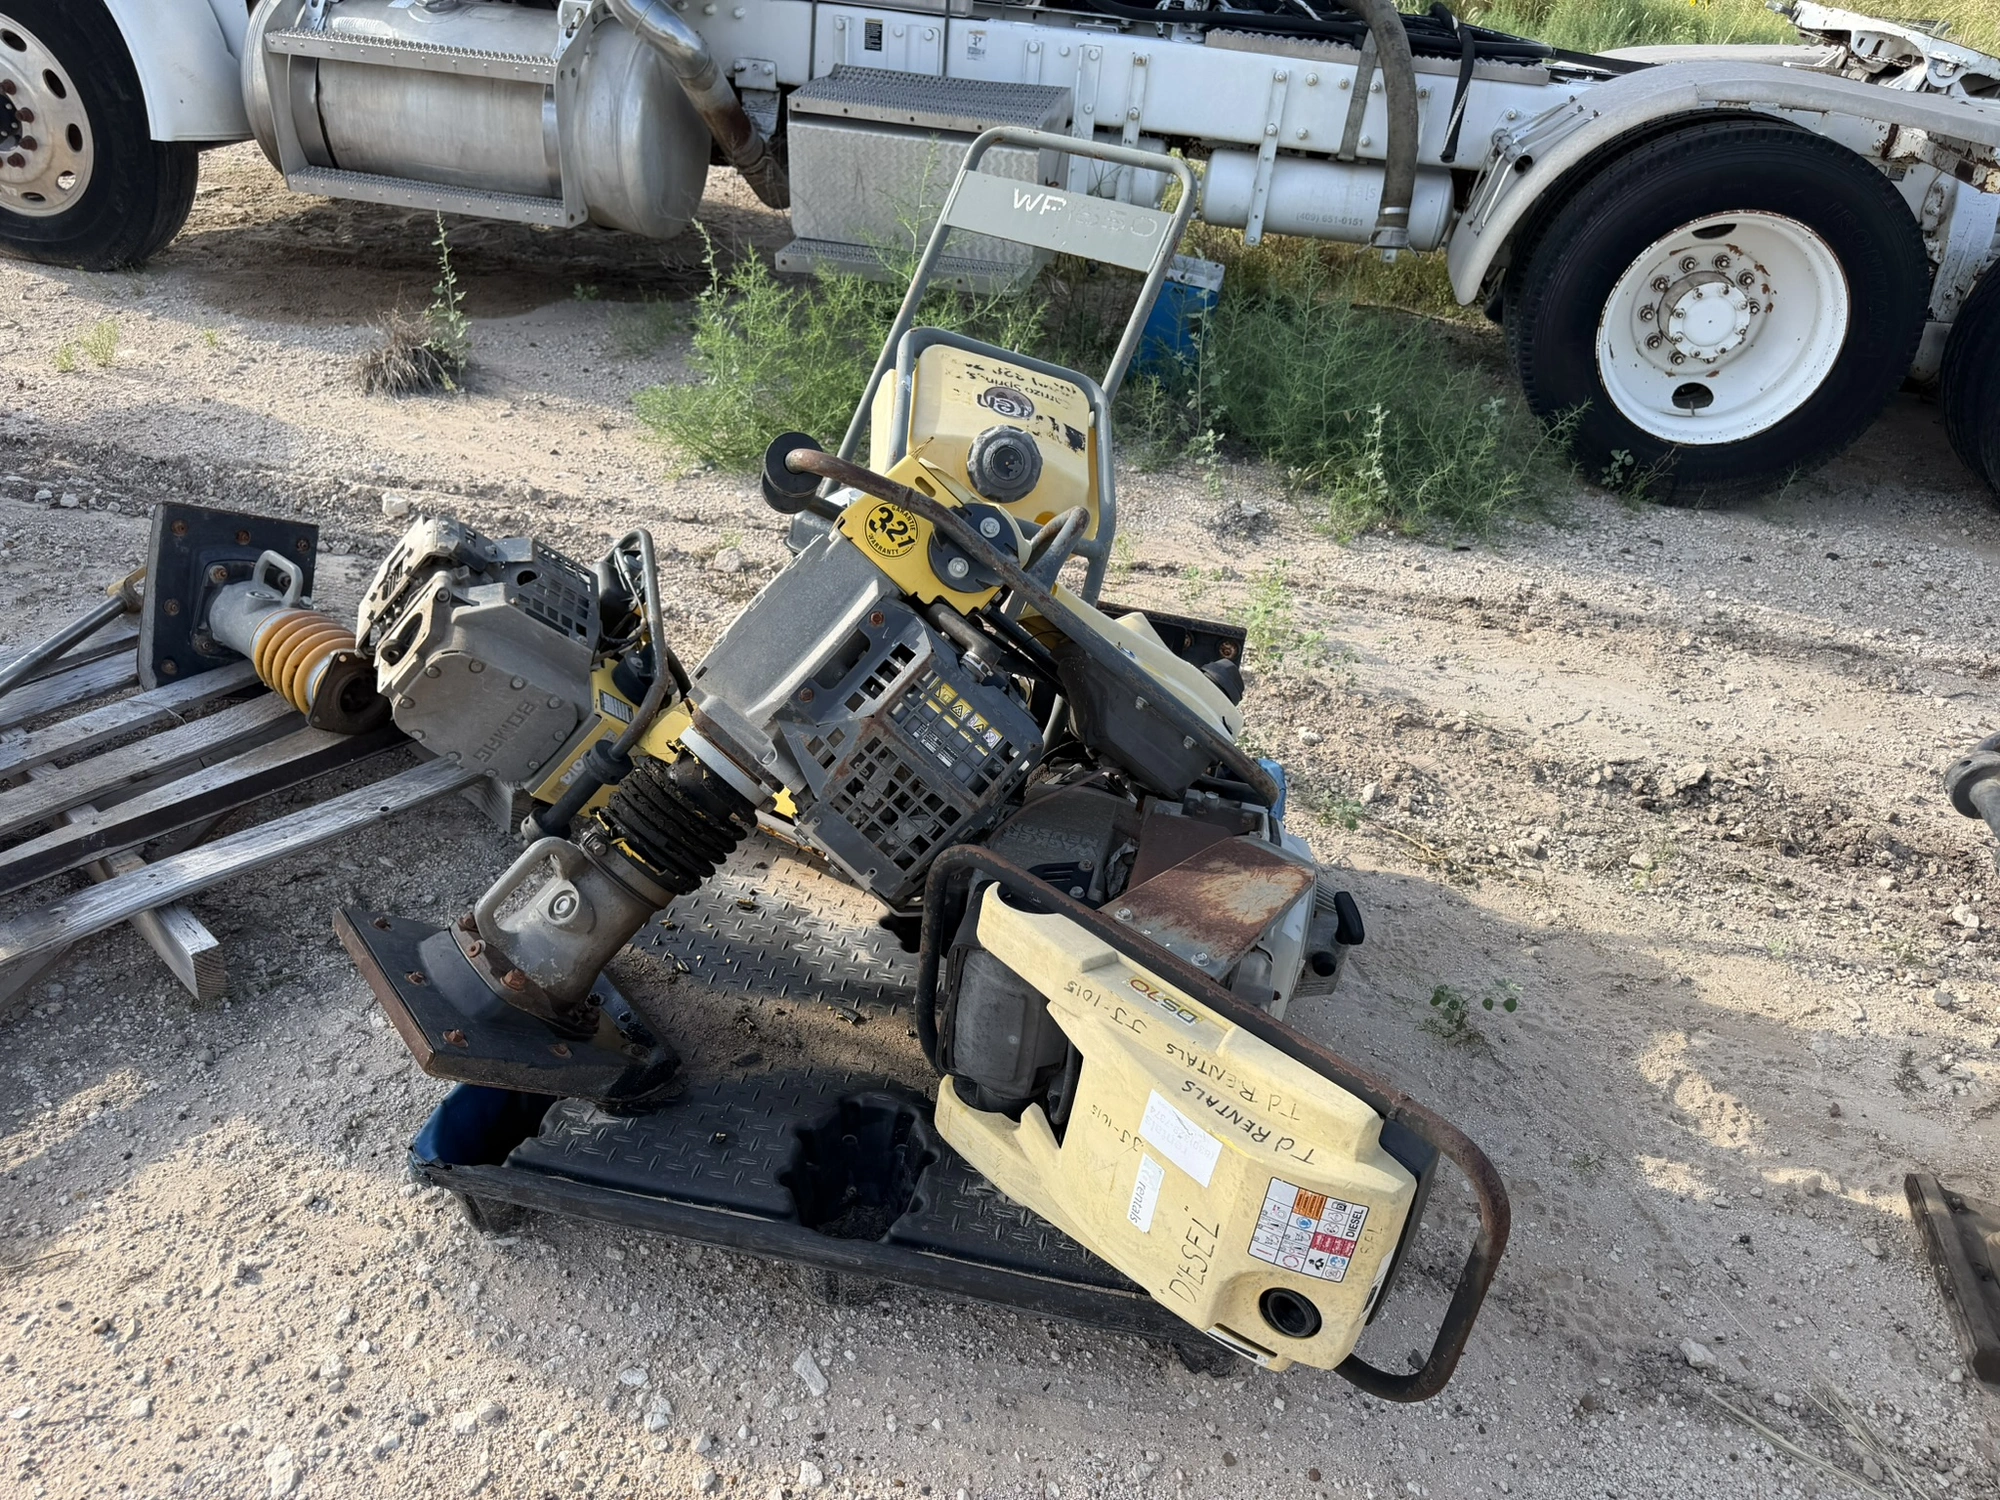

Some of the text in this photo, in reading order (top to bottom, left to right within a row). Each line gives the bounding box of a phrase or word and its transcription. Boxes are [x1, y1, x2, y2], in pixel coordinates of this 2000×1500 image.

[1296, 212, 1364, 227] (409) 651-0151
[1820, 201, 1889, 340] IRONMAN
[473, 701, 535, 763] BOMAG
[1129, 979, 1198, 1024] DS70
[1166, 1042, 1259, 1104] RENTALS
[1181, 1080, 1272, 1144] RENTALS
[1129, 1181, 1146, 1224] rentals
[1345, 1209, 1365, 1238] DIESEL
